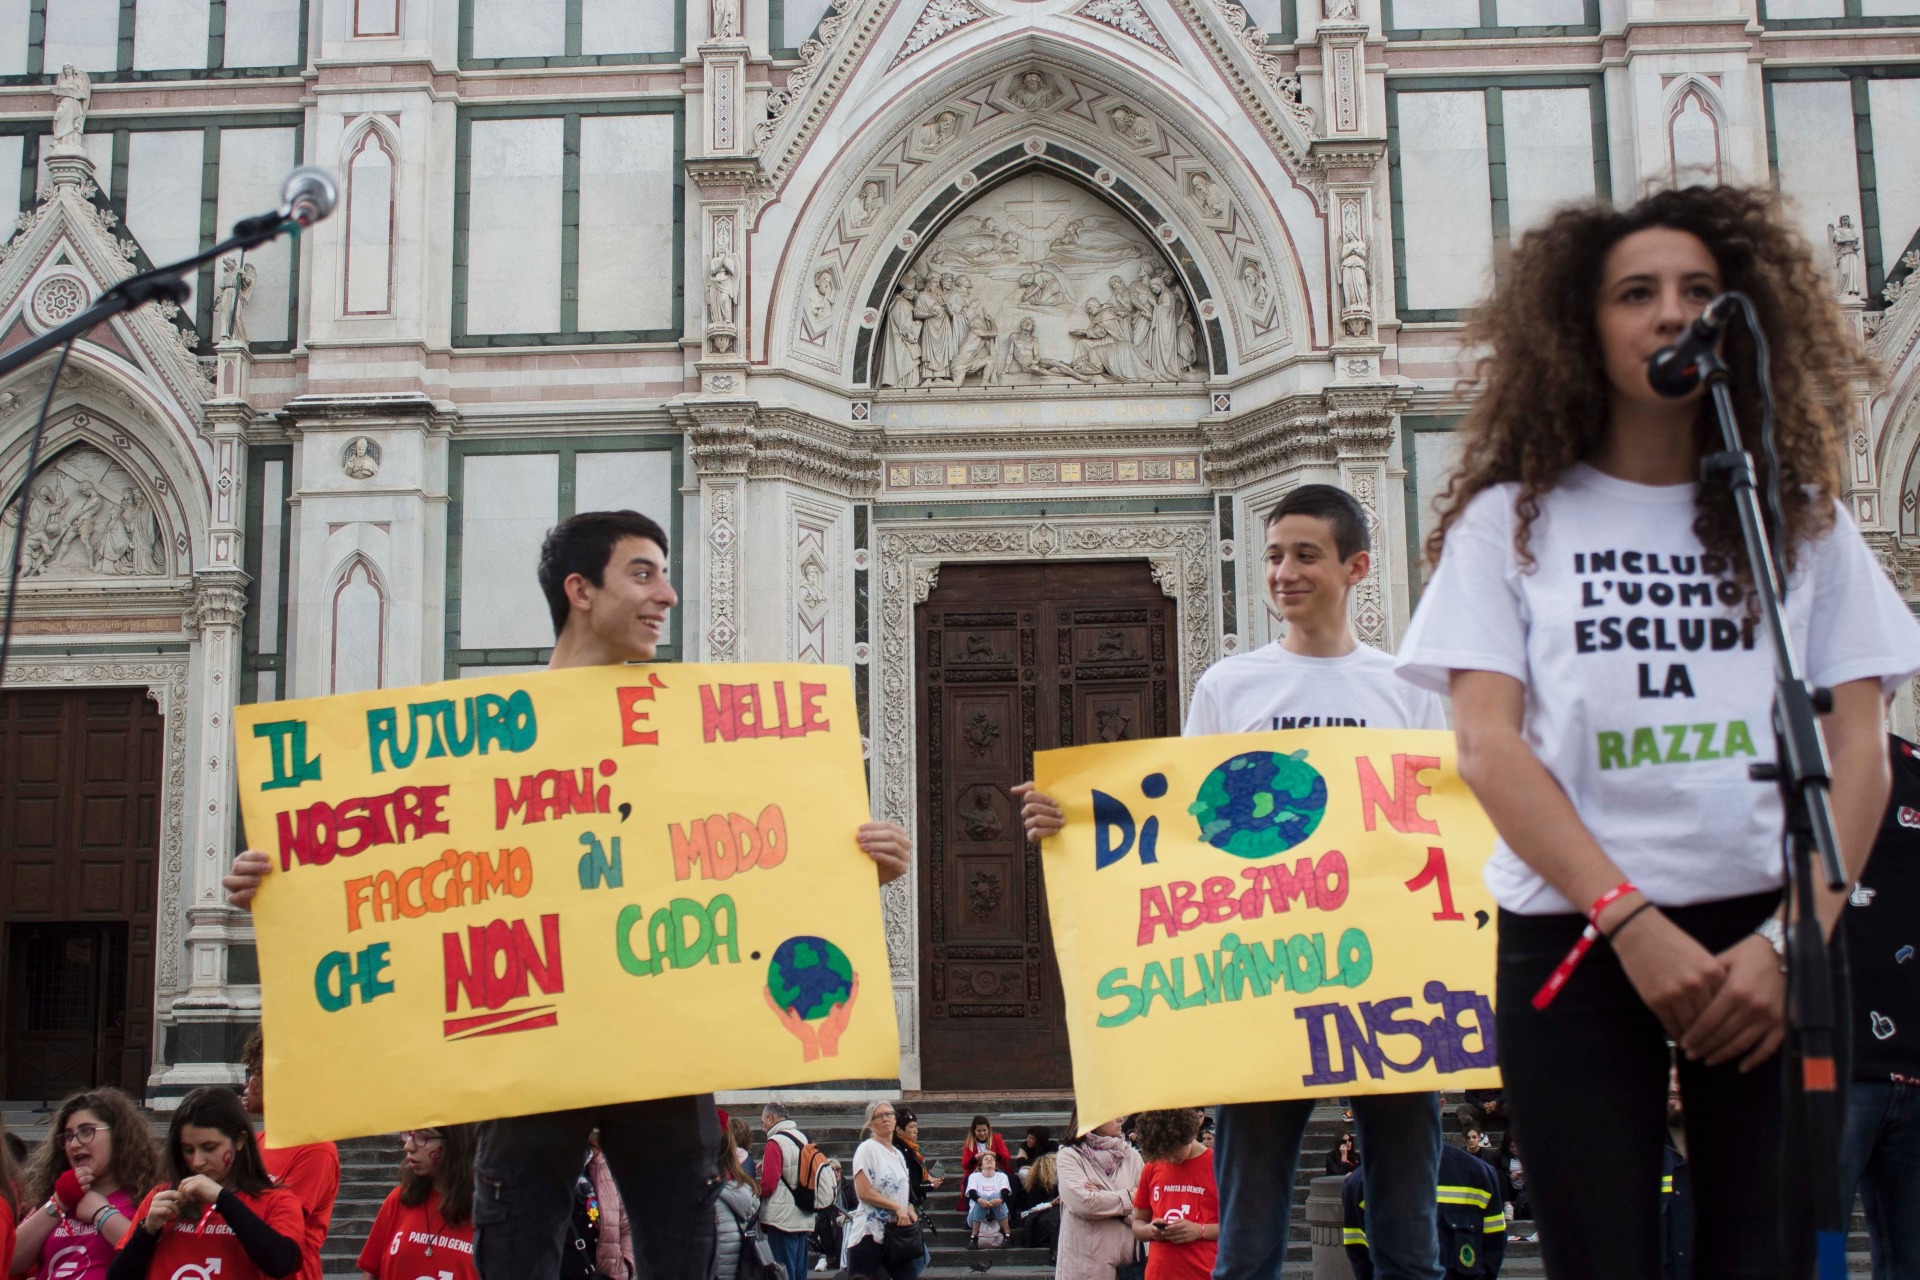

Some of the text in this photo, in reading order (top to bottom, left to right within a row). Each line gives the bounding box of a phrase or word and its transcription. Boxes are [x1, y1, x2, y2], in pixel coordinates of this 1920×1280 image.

[1574, 550, 1736, 576] INCLUD
[1582, 581, 1743, 608] L'UOMO
[1575, 617, 1755, 653] ESCLUDI
[1638, 663, 1695, 698] LA
[253, 672, 830, 791] IL FUTURO È NELLE
[1597, 720, 1757, 770] RAZZA
[276, 784, 450, 872] NOSTRE
[1091, 753, 1441, 872] Di NE
[668, 803, 788, 881] MODO
[1405, 847, 1490, 931] 1,
[314, 893, 762, 1013] CHE NON CADA.
[1153, 1186, 1160, 1201] 5
[205, 1224, 216, 1234] DI
[390, 1231, 404, 1255] 5
[438, 1236, 449, 1247] DI
